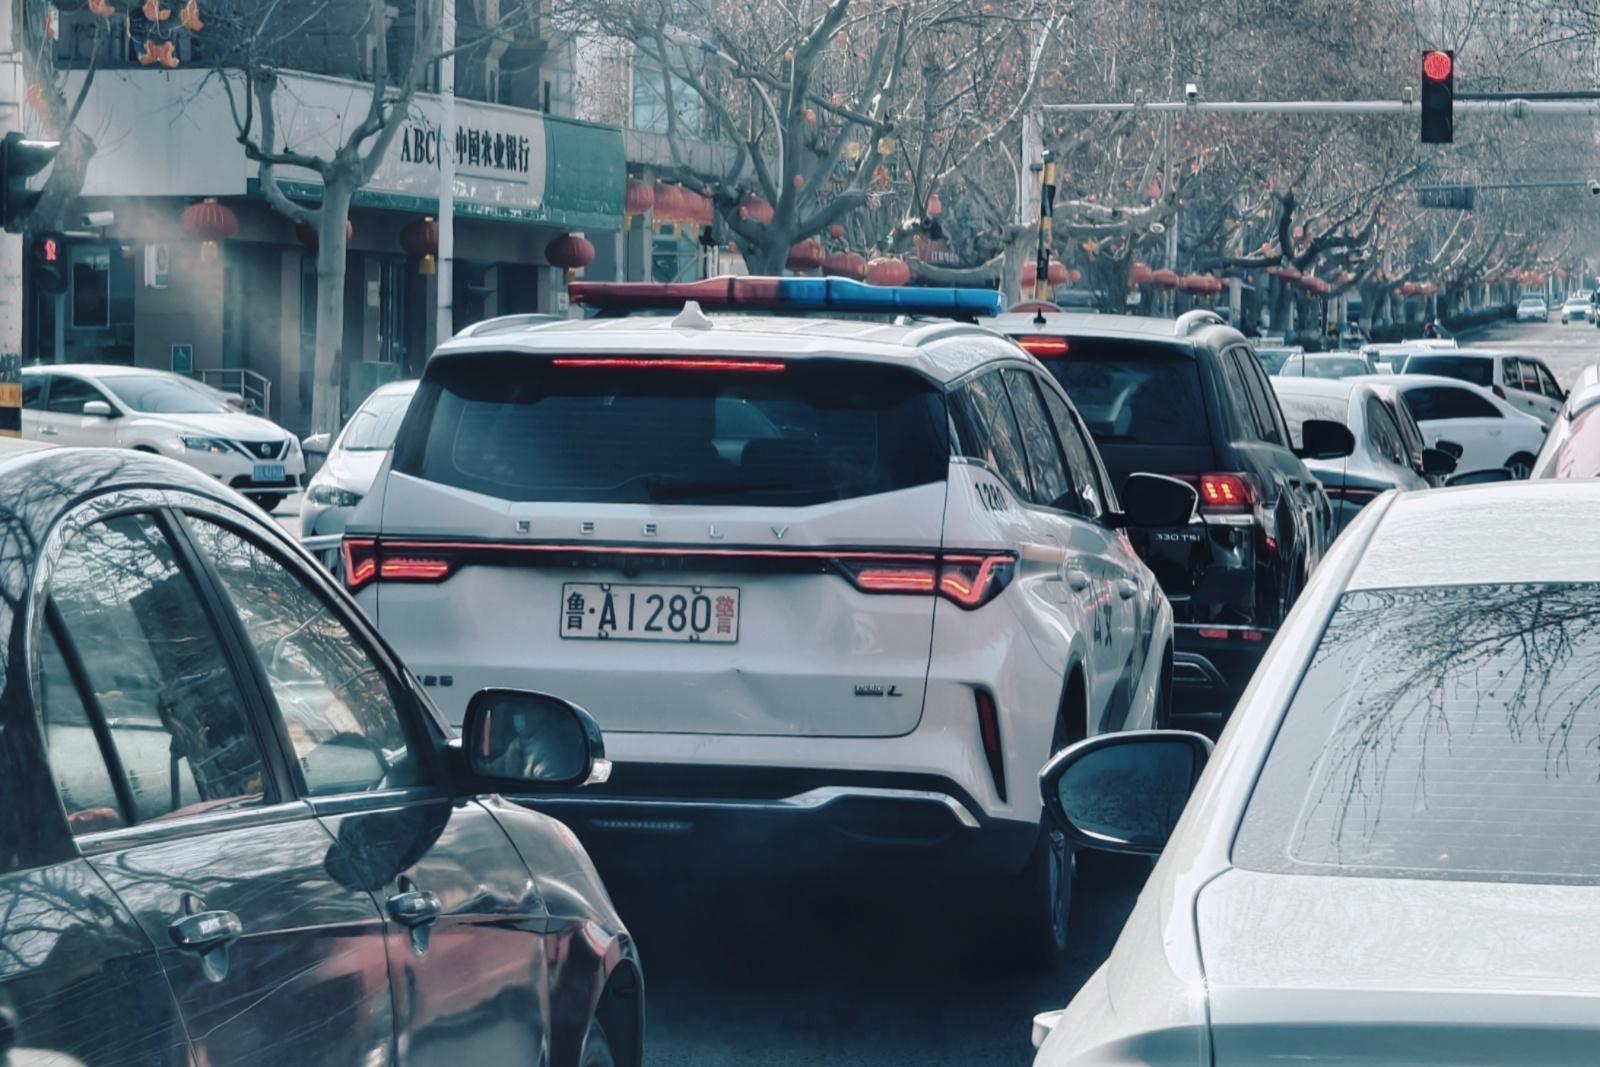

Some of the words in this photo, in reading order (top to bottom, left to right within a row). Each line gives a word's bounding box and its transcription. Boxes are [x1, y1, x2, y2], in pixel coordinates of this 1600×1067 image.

[401, 126, 435, 164] ABC
[456, 125, 530, 173] 中国农业银行
[975, 482, 1008, 512] 1280
[516, 520, 788, 539] GEELY
